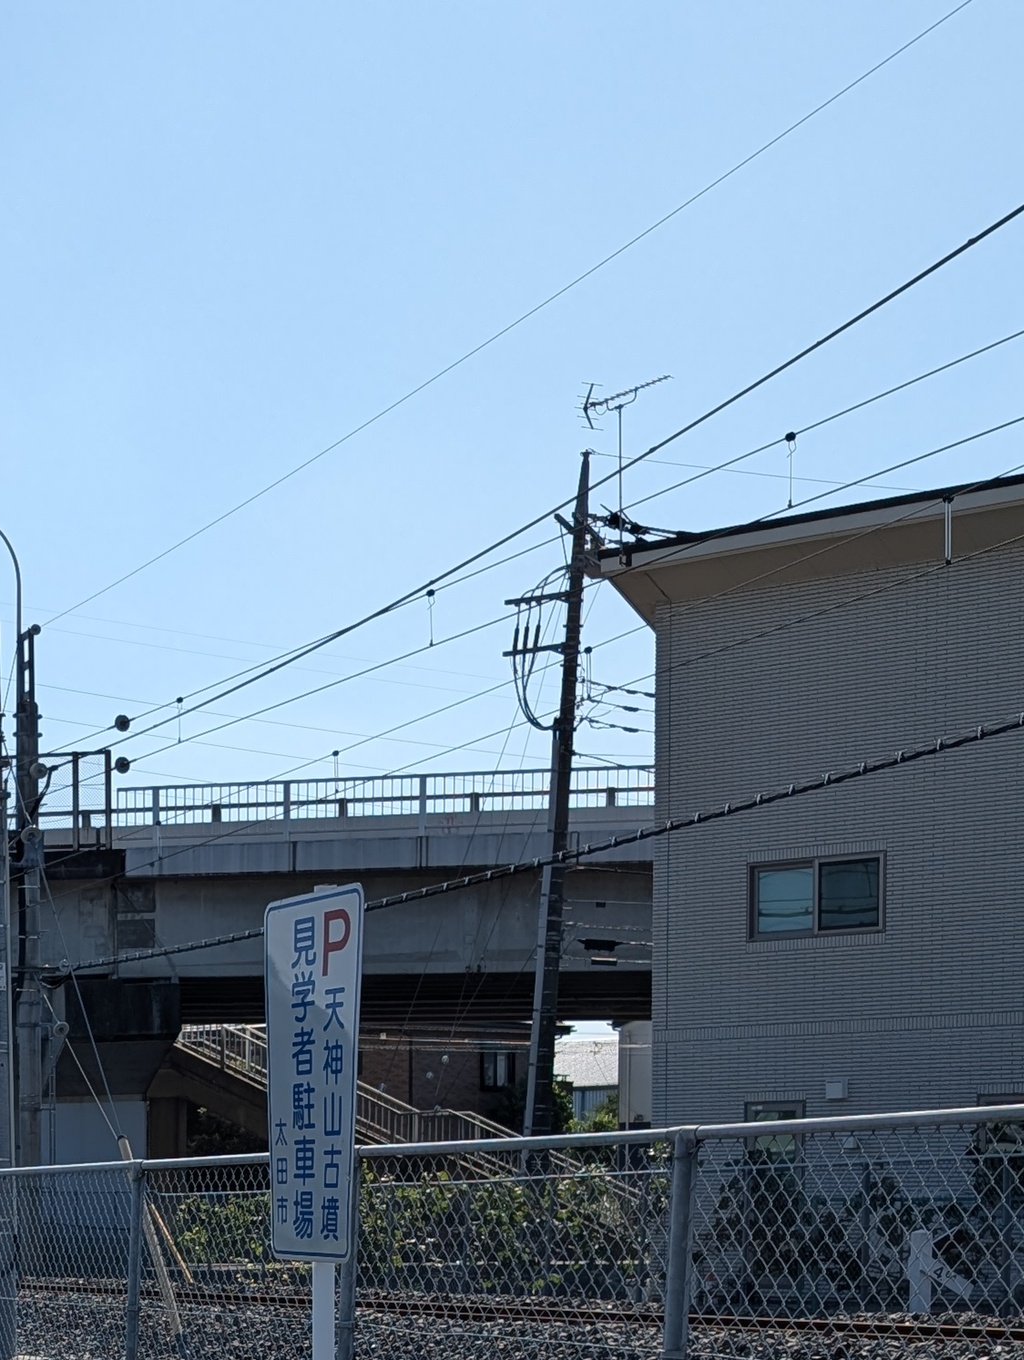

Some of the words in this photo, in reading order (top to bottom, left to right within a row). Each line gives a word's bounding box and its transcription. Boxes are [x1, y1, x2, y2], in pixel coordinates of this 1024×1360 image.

[322, 908, 351, 977] P
[291, 916, 316, 1240] 見学者駐車場
[320, 986, 346, 1242] 天神山古墳
[274, 1118, 289, 1225] 太田市
